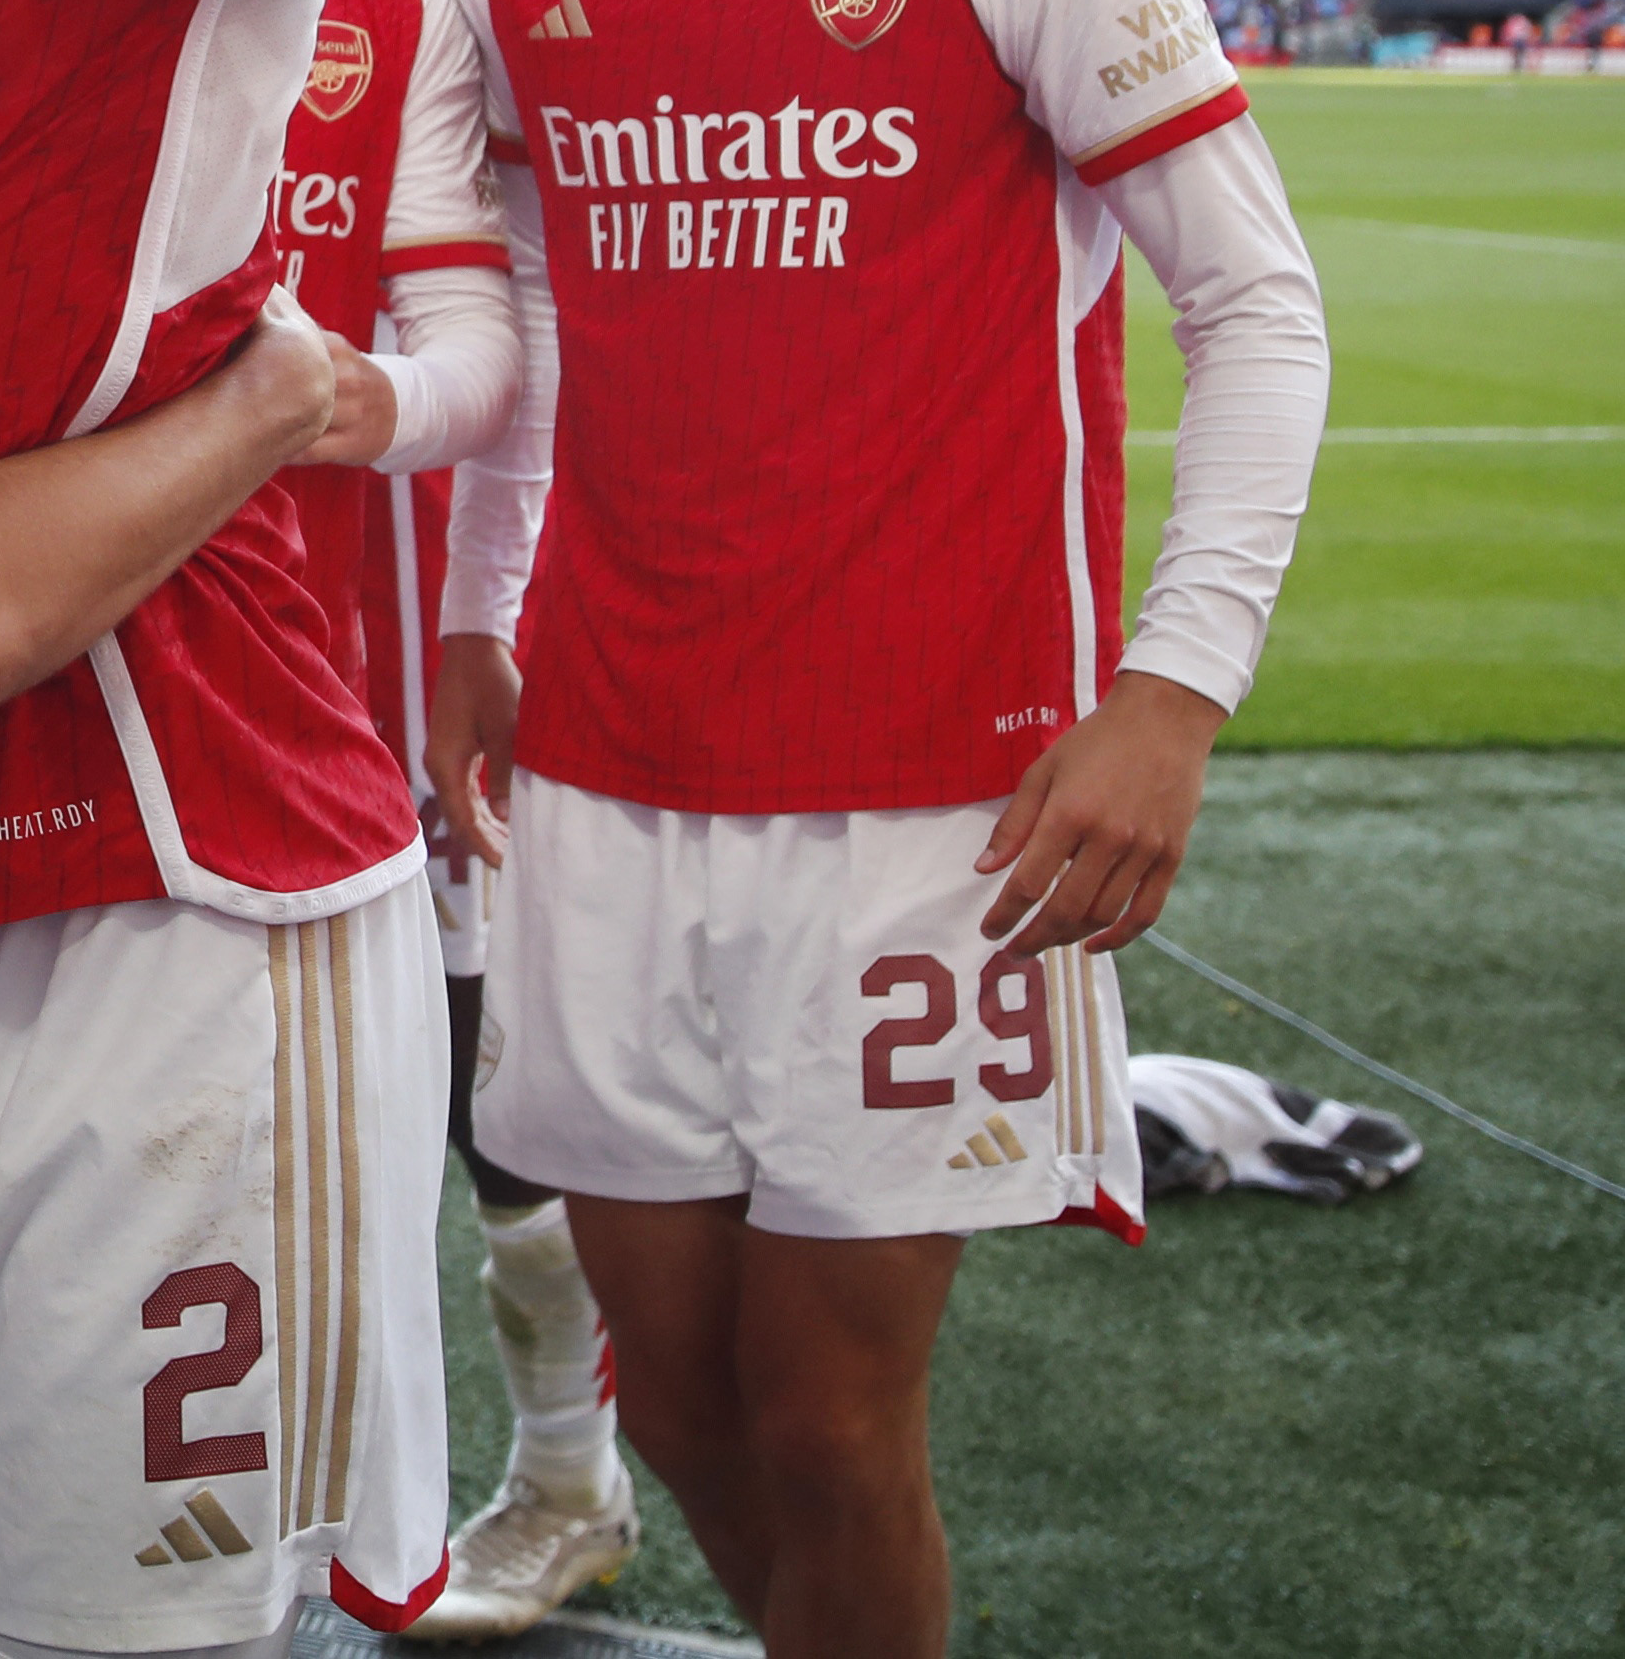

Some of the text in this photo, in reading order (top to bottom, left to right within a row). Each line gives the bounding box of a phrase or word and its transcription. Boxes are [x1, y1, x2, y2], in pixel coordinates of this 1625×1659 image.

[317, 39, 360, 56] senal
[1097, 10, 1216, 99] RWAN
[540, 94, 917, 189] Emirates
[588, 196, 849, 271] FLY BETTER
[860, 948, 1055, 1112] 29
[141, 1261, 269, 1484] 2
